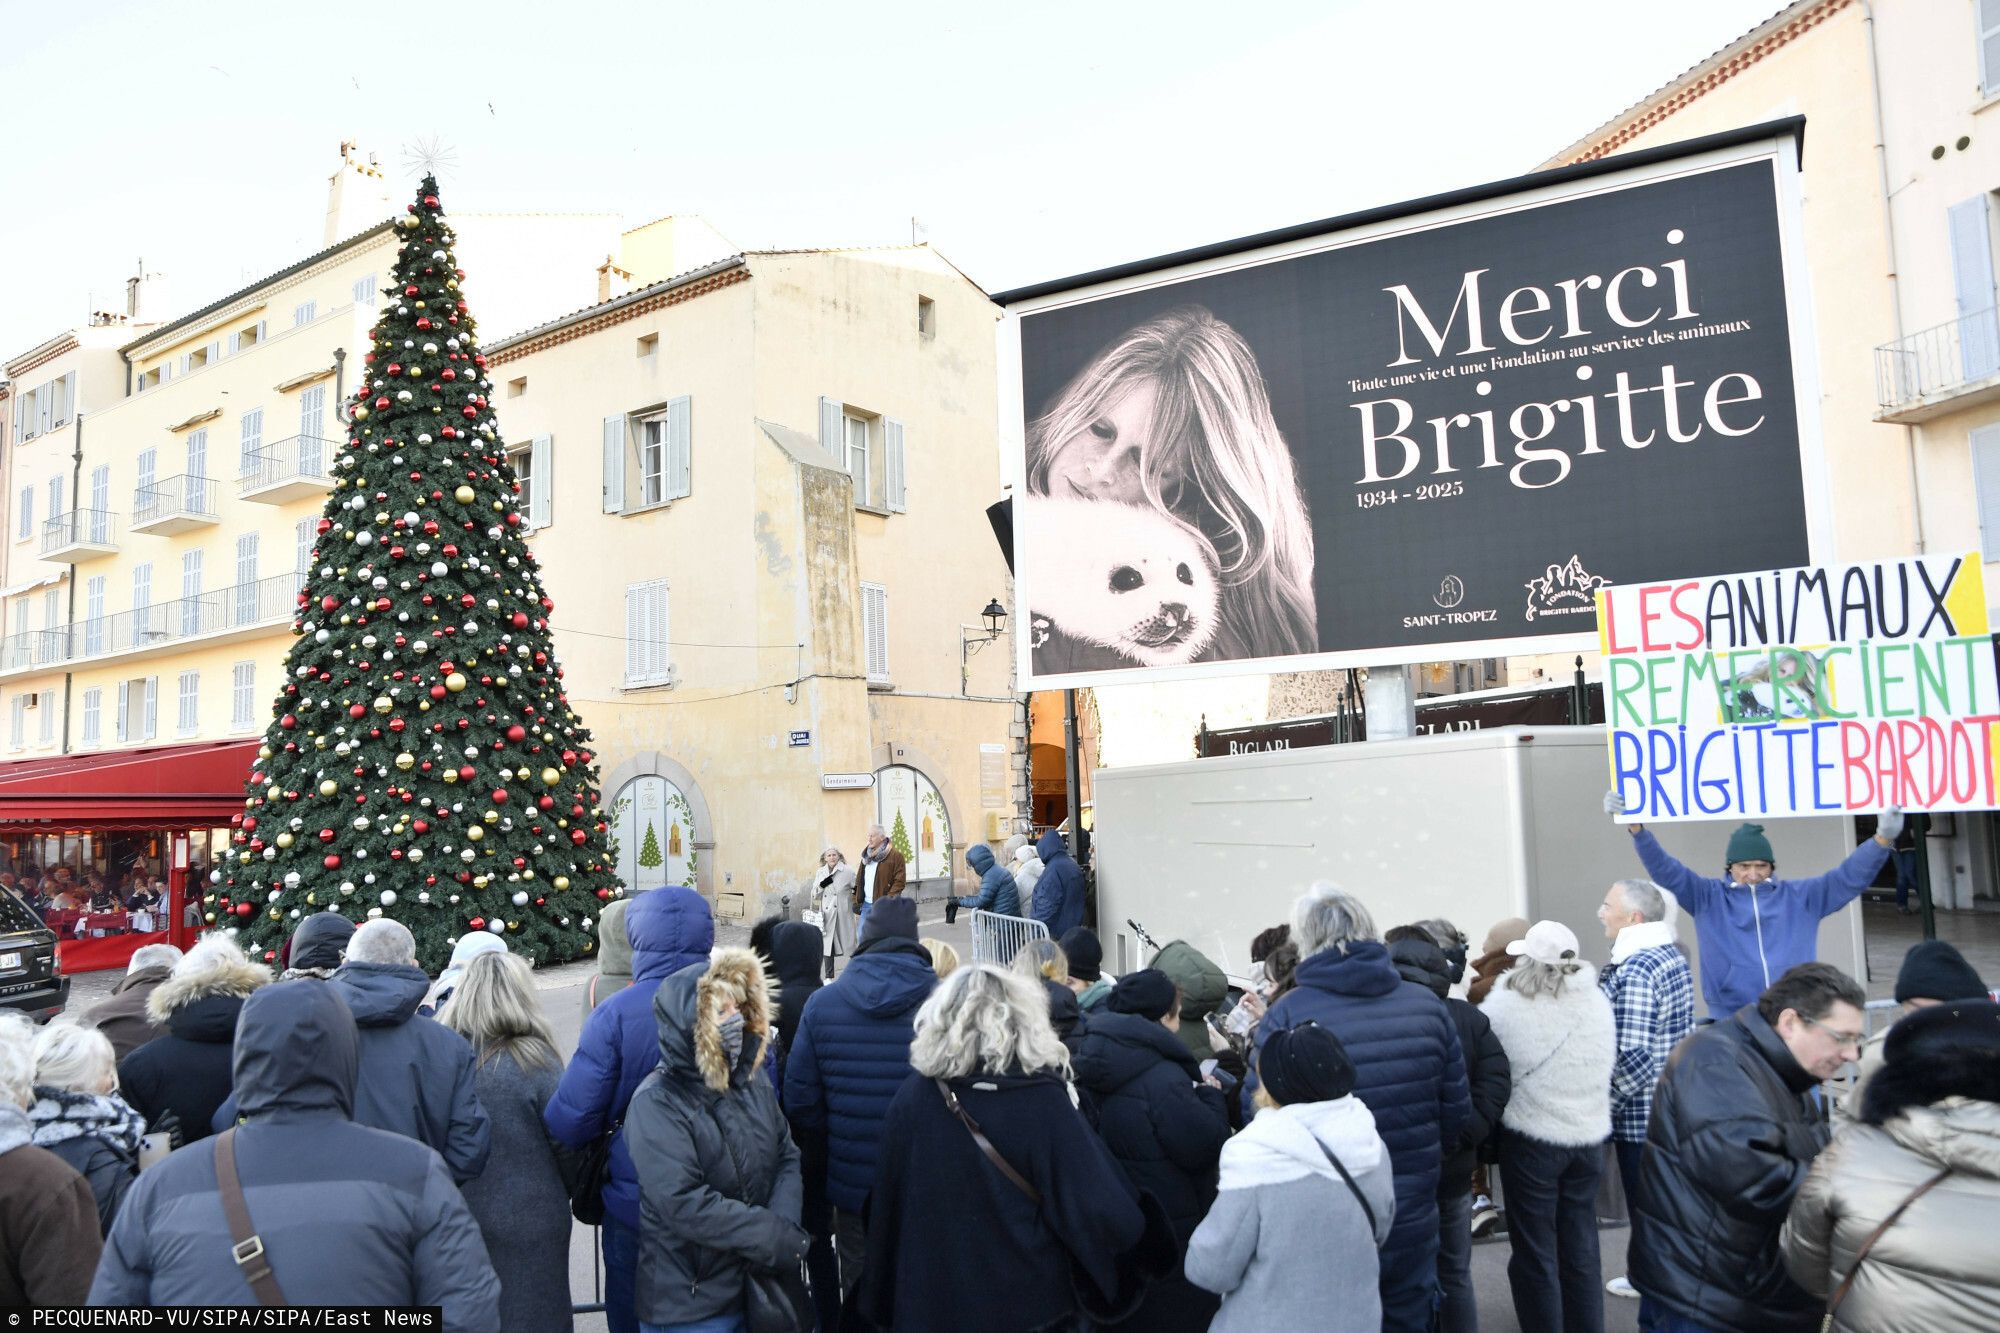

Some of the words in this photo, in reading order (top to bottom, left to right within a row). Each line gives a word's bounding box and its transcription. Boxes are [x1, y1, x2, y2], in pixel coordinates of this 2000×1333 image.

[1382, 229, 1699, 367] Merci
[1348, 377, 1388, 392] Toute
[1391, 374, 1417, 386] une
[1420, 368, 1440, 381] vie
[1442, 366, 1456, 377] et
[1460, 363, 1488, 376] une
[1491, 349, 1566, 371] Fondation
[1570, 347, 1588, 358] au
[1592, 335, 1645, 354] service
[1648, 330, 1675, 346] des
[1678, 320, 1751, 341] animaux
[1350, 365, 1765, 489] Brigitte
[1356, 490, 1398, 508] 1934
[1416, 481, 1464, 500] 2025
[1403, 610, 1498, 628] SAINT-TROPEZ
[1539, 608, 1570, 616] BRIGITTE
[1546, 590, 1591, 606] FONDATION
[1605, 582, 1704, 654] LES
[1609, 636, 1993, 728] REMERCIENT
[1613, 722, 1842, 816] BRIGITTE
[1841, 715, 2000, 809] BARDOT
[1, 983, 36, 995] ROVER
